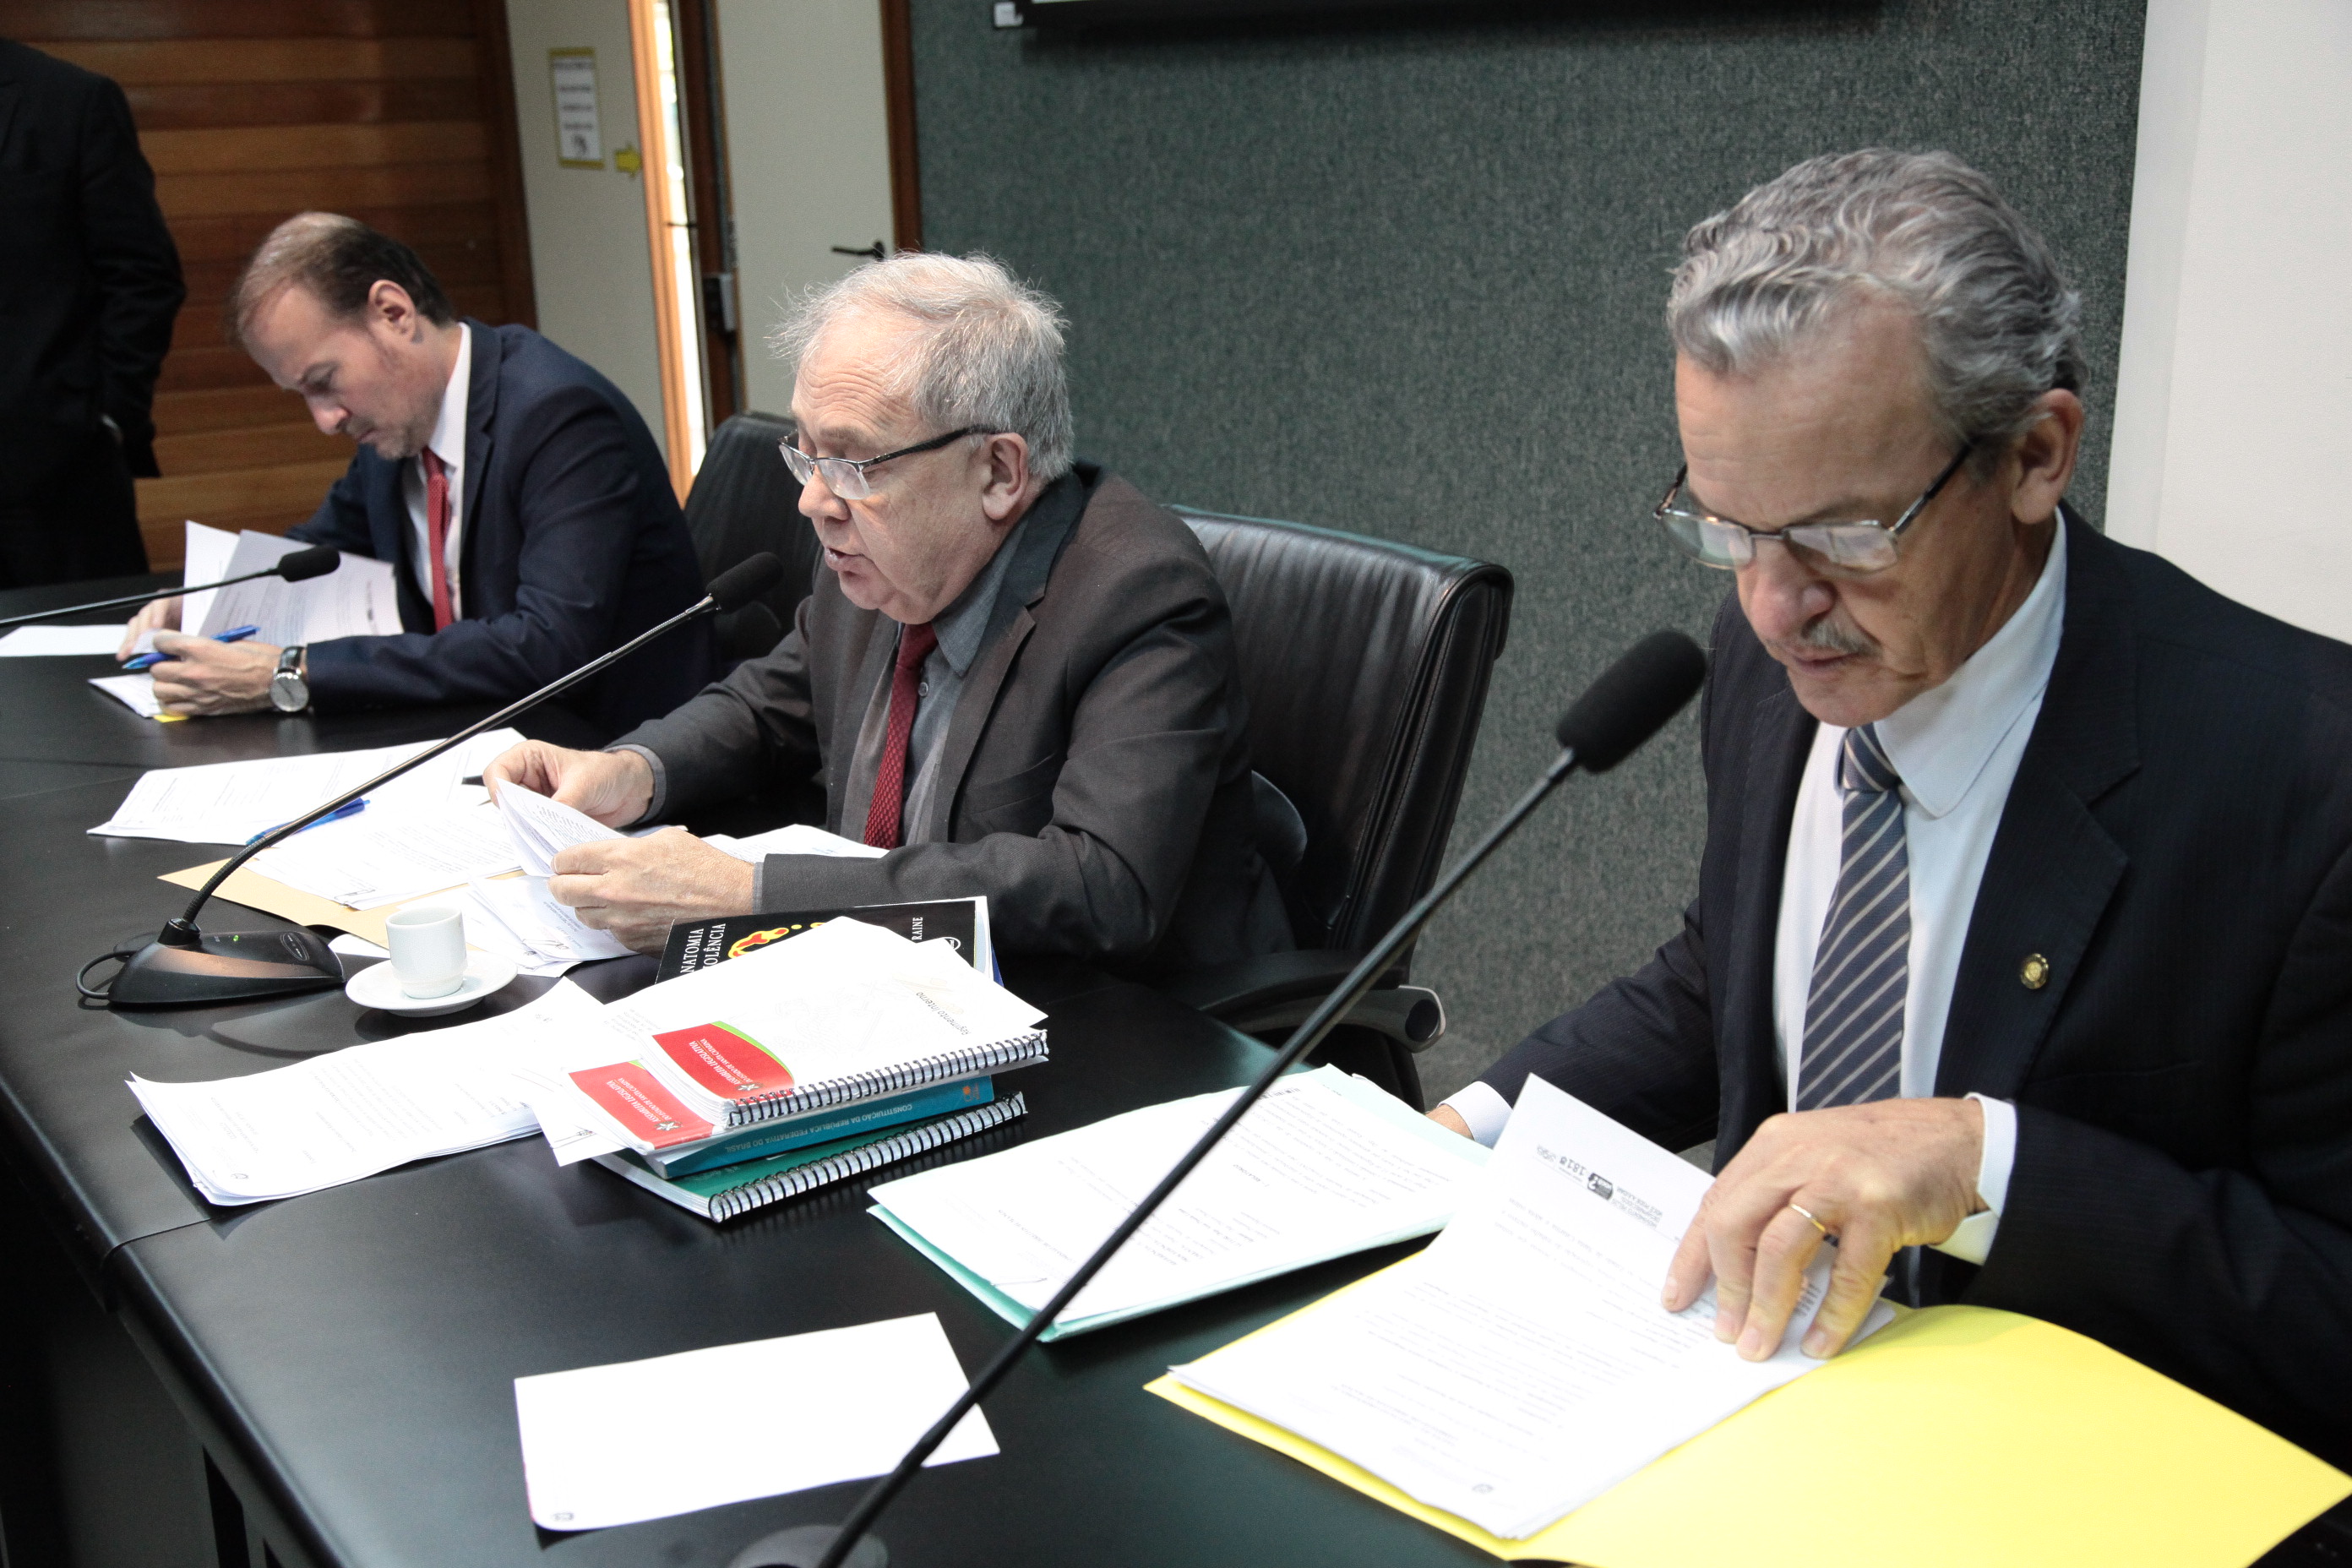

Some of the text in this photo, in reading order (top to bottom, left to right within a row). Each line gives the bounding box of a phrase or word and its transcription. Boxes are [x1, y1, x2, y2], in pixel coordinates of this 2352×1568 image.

[912, 917, 923, 940] RAINE
[679, 928, 705, 973] NATOMIA
[702, 923, 727, 969] OLÊNCIA
[916, 992, 972, 1036] Regimento Interno
[689, 1041, 718, 1066] LEGISLATIVA
[700, 1038, 720, 1055] CATARINA
[715, 1054, 729, 1064] SANTA
[607, 1081, 636, 1102] LEGISLATIVA
[862, 1103, 912, 1122] CONSTITUIÇÃO
[765, 1129, 808, 1143] FEDERATIVA
[809, 1119, 849, 1133] REPÚBLICA
[724, 1141, 751, 1152] BRASIL
